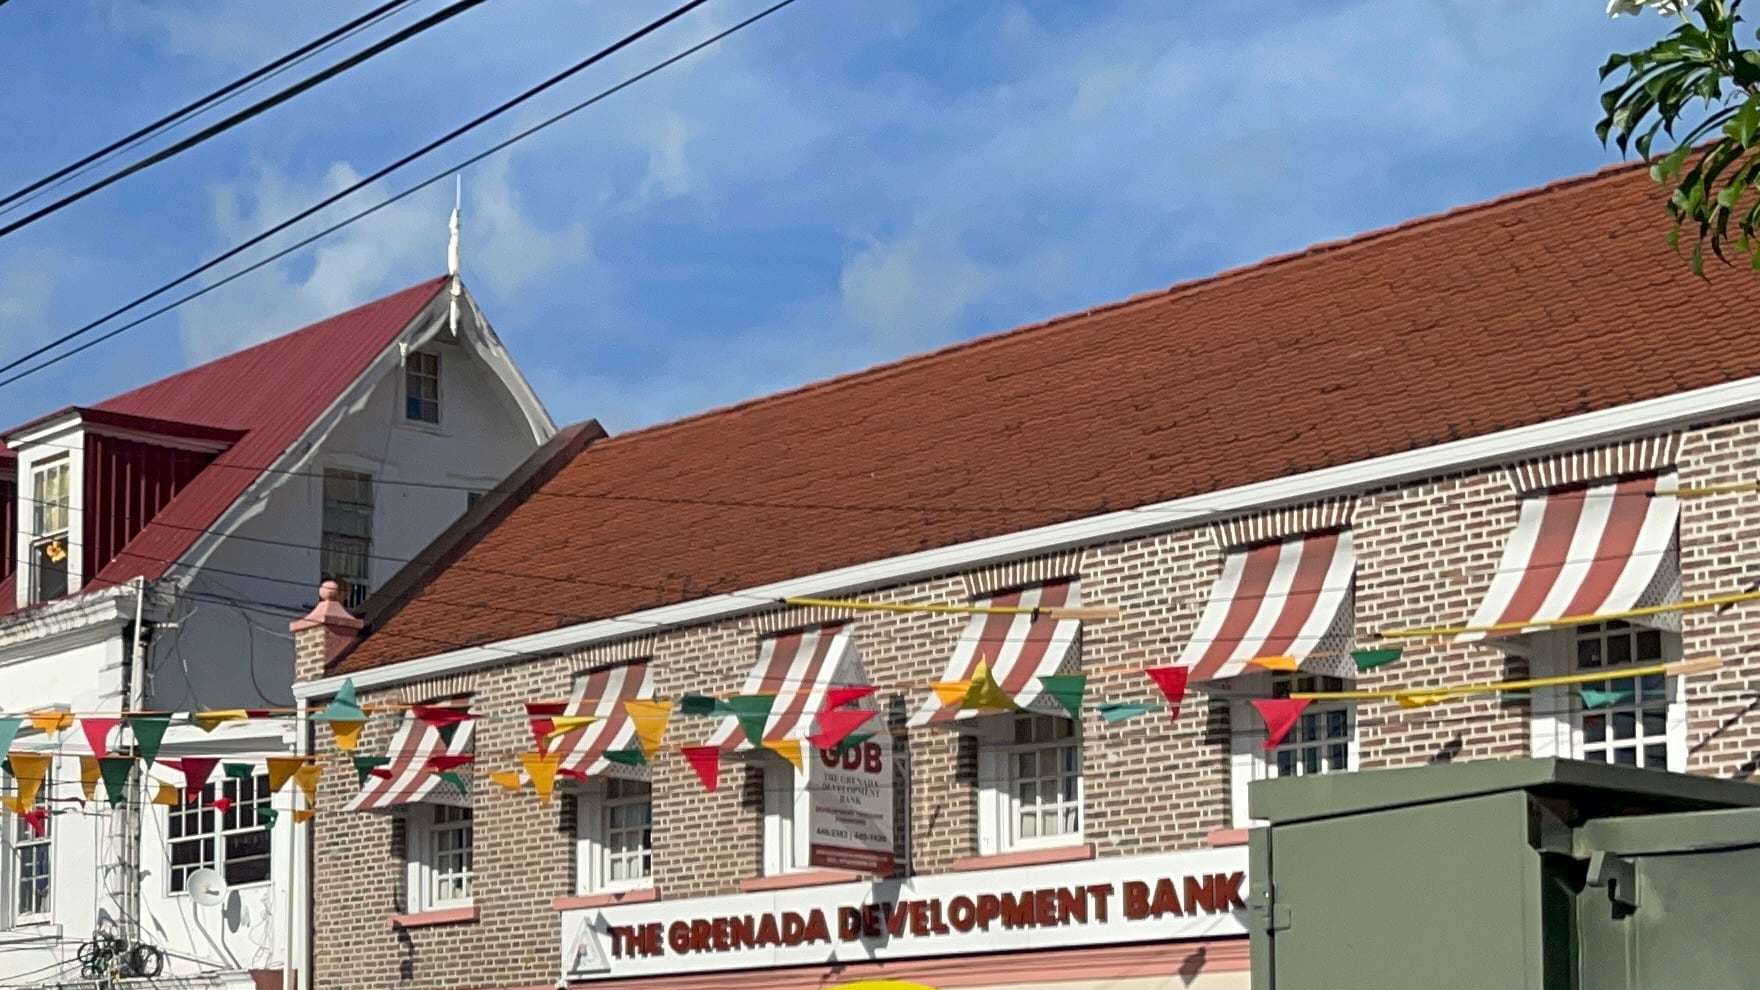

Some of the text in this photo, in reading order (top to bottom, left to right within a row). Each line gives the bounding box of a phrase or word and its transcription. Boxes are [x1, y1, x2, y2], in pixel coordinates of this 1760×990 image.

[820, 742, 882, 774] GDB
[609, 871, 1246, 960] THE GRENADA DEVELOPMENT BANK
